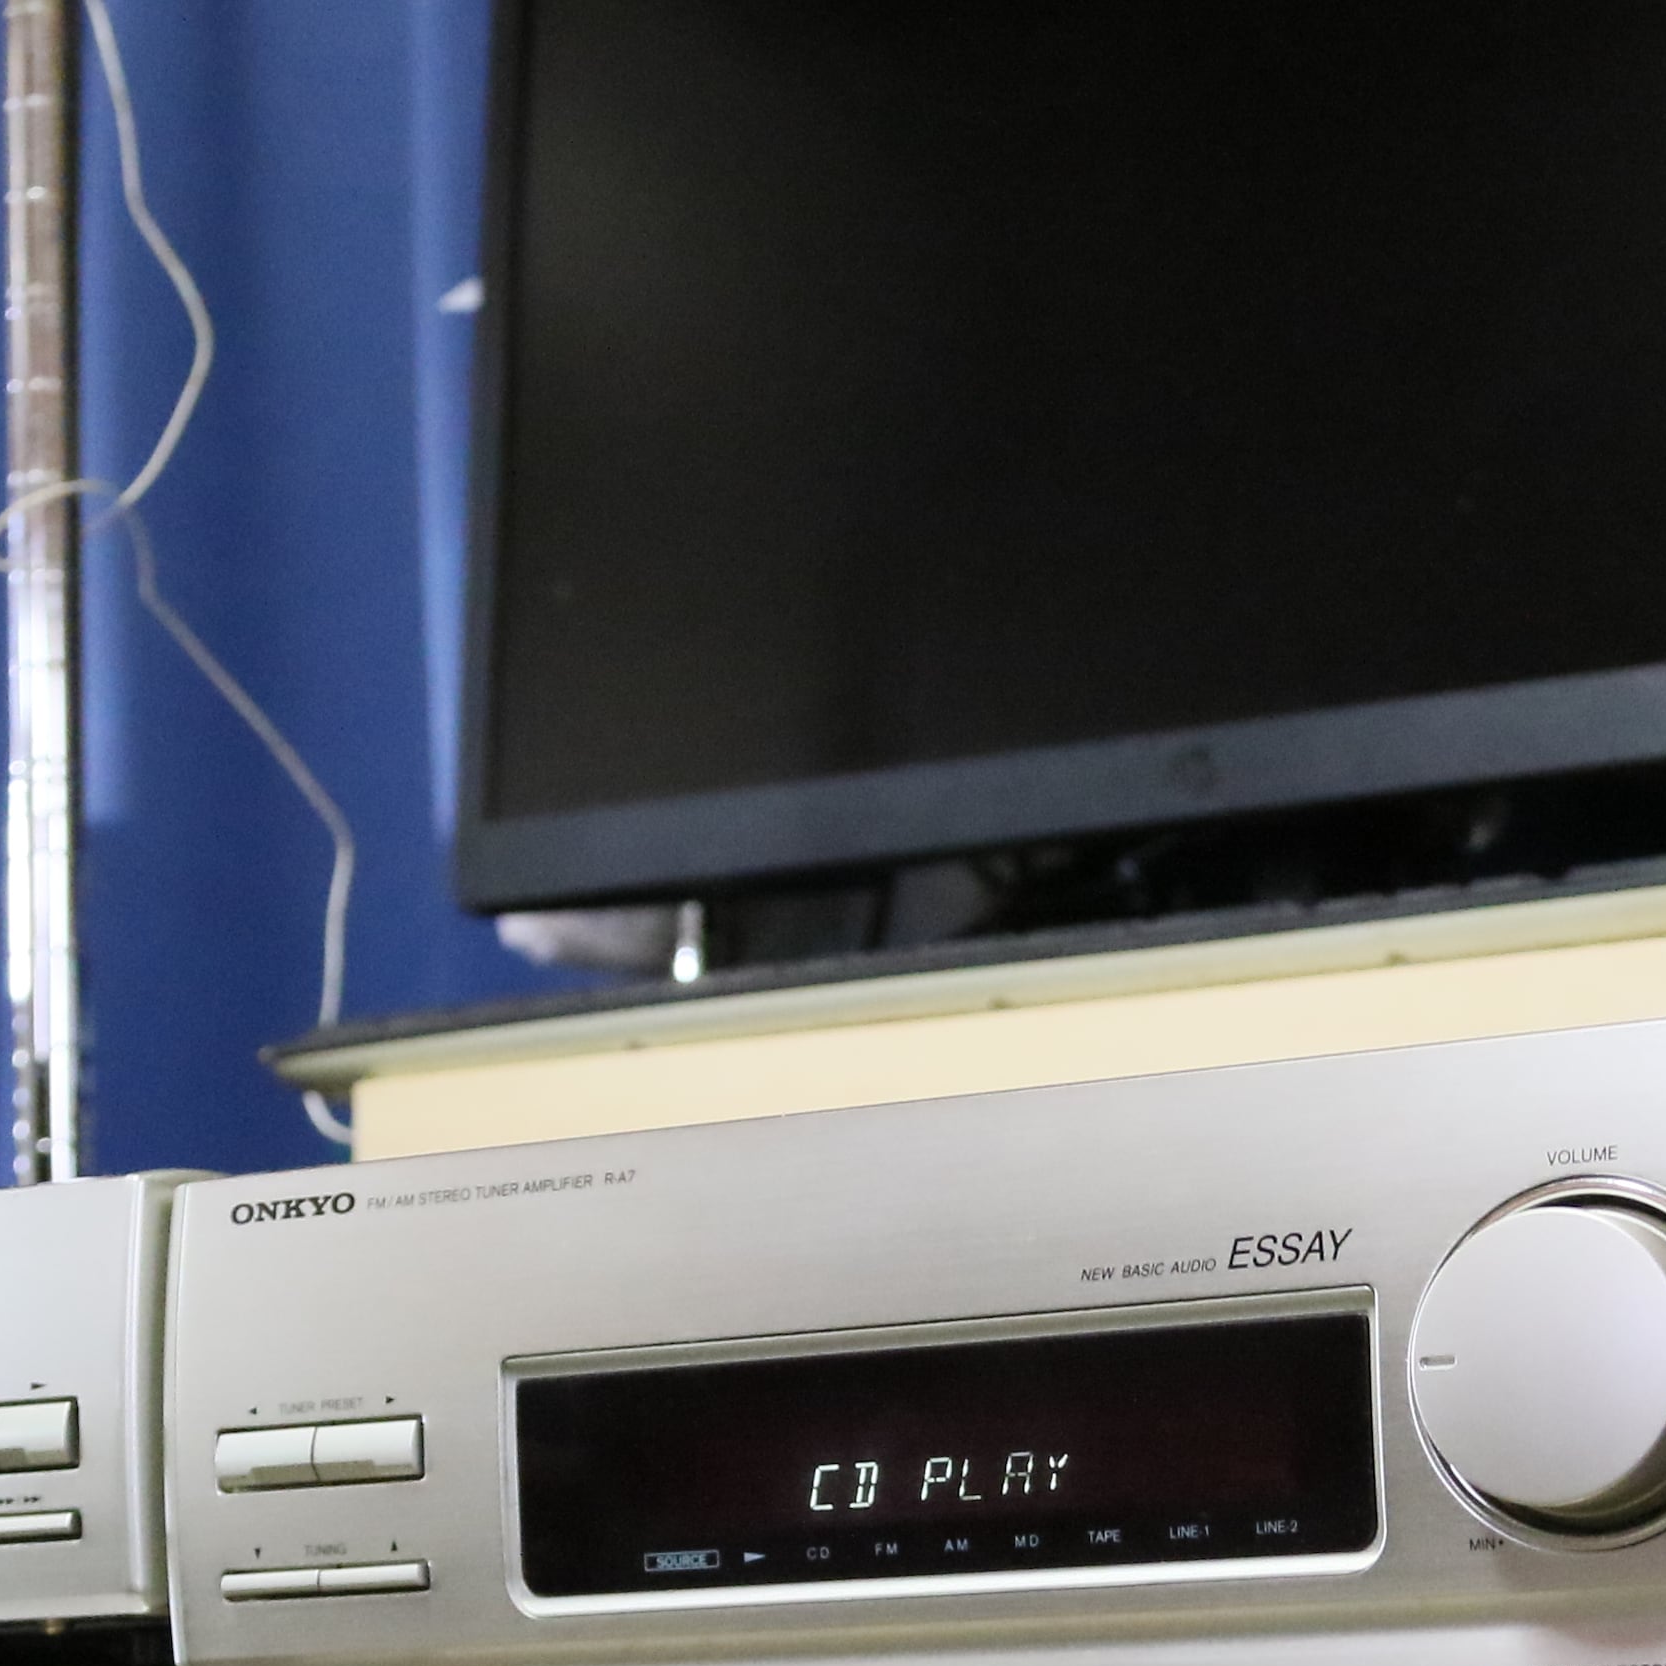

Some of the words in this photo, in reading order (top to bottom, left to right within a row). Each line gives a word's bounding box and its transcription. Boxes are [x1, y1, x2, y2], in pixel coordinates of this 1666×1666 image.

[1546, 1145, 1618, 1167] VOLUME
[230, 1192, 356, 1225] ONKYO
[418, 1188, 471, 1206] STEREO
[475, 1182, 520, 1199] TUNER
[522, 1174, 594, 1194] AMPLIFIER
[1228, 1228, 1353, 1271] ESSAY
[1081, 1267, 1115, 1282] NEW
[1122, 1262, 1165, 1279] BASIC
[1171, 1258, 1217, 1274] AUDIO
[809, 1461, 879, 1511] CD
[920, 1451, 1069, 1501] PLAY
[1169, 1524, 1211, 1540] LINE-1
[1255, 1519, 1299, 1535] LINE-2
[1014, 1534, 1040, 1549] MD
[1087, 1528, 1123, 1544] TAPE
[874, 1542, 899, 1557] FM
[943, 1539, 970, 1553] AM
[1469, 1538, 1496, 1552] MIN
[805, 1546, 831, 1561] CD
[655, 1554, 709, 1570] SOURCE
